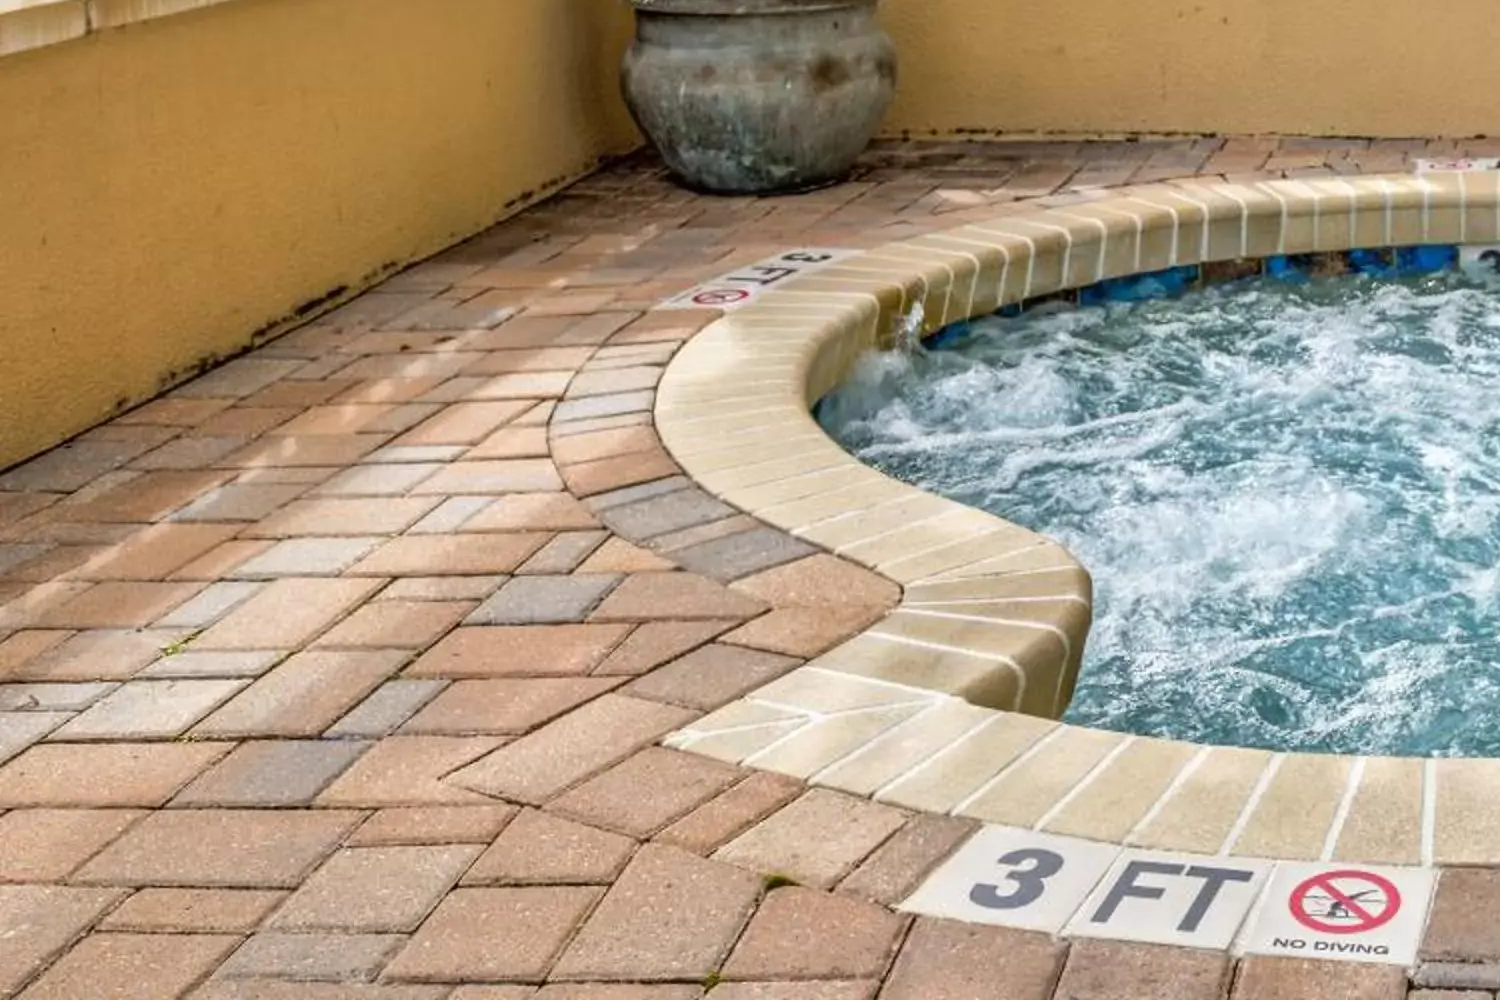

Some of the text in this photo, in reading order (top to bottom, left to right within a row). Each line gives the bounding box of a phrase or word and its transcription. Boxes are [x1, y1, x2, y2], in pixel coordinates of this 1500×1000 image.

[968, 847, 1255, 934] 3 FT
[1272, 937, 1390, 956] NO DIVING
